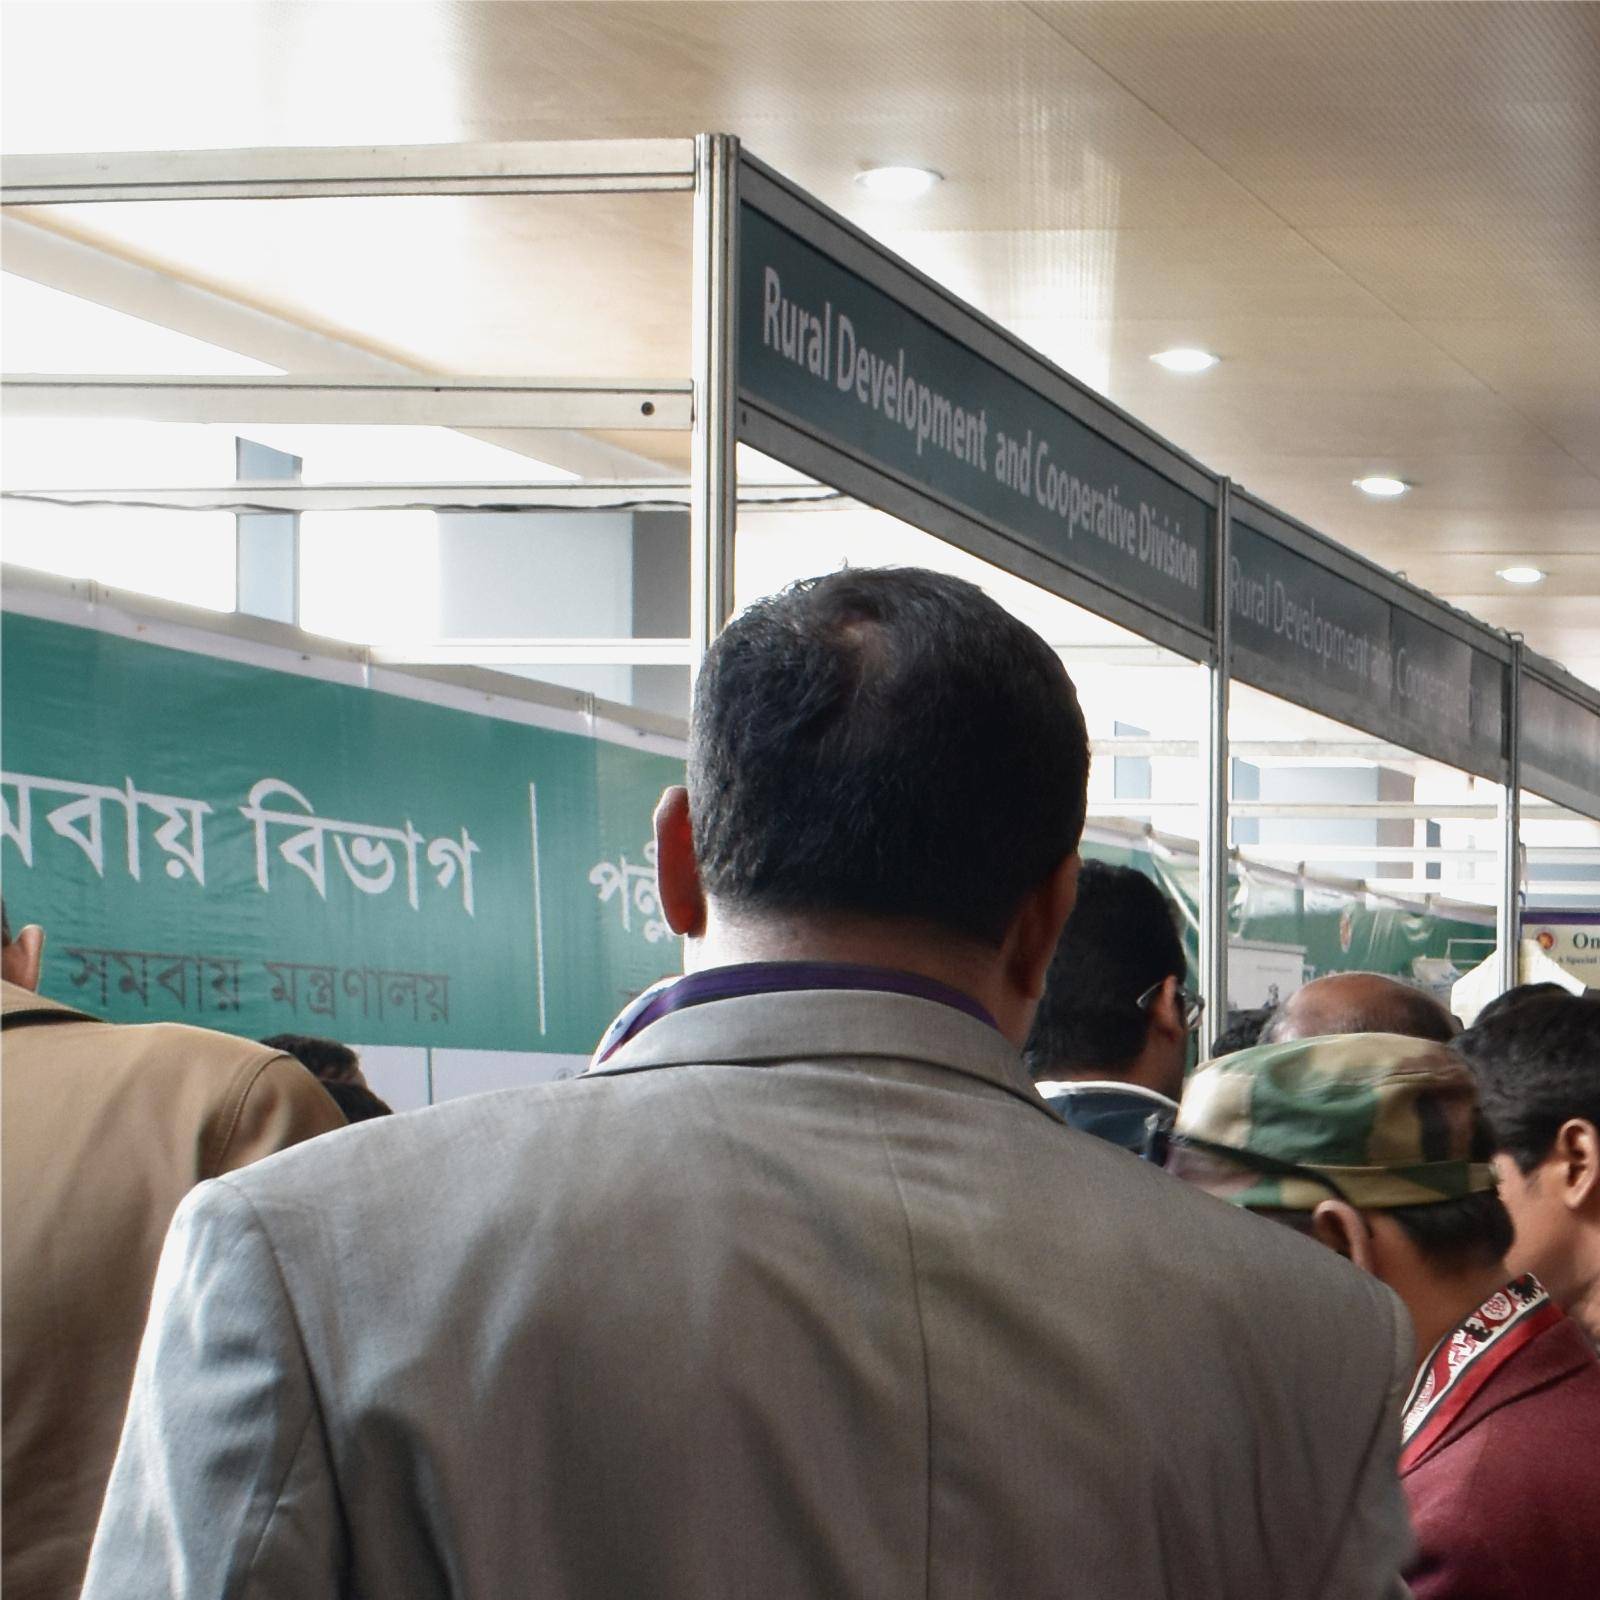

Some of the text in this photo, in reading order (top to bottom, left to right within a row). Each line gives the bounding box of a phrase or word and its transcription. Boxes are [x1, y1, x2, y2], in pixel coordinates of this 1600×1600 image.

[763, 266, 1199, 590] Rural Development and Cooperative Division
[1230, 555, 1369, 677] Rural Development
[239, 777, 480, 918] বিভাগ
[64, 948, 452, 1023] সমবায় মন্ত্রণালয়
